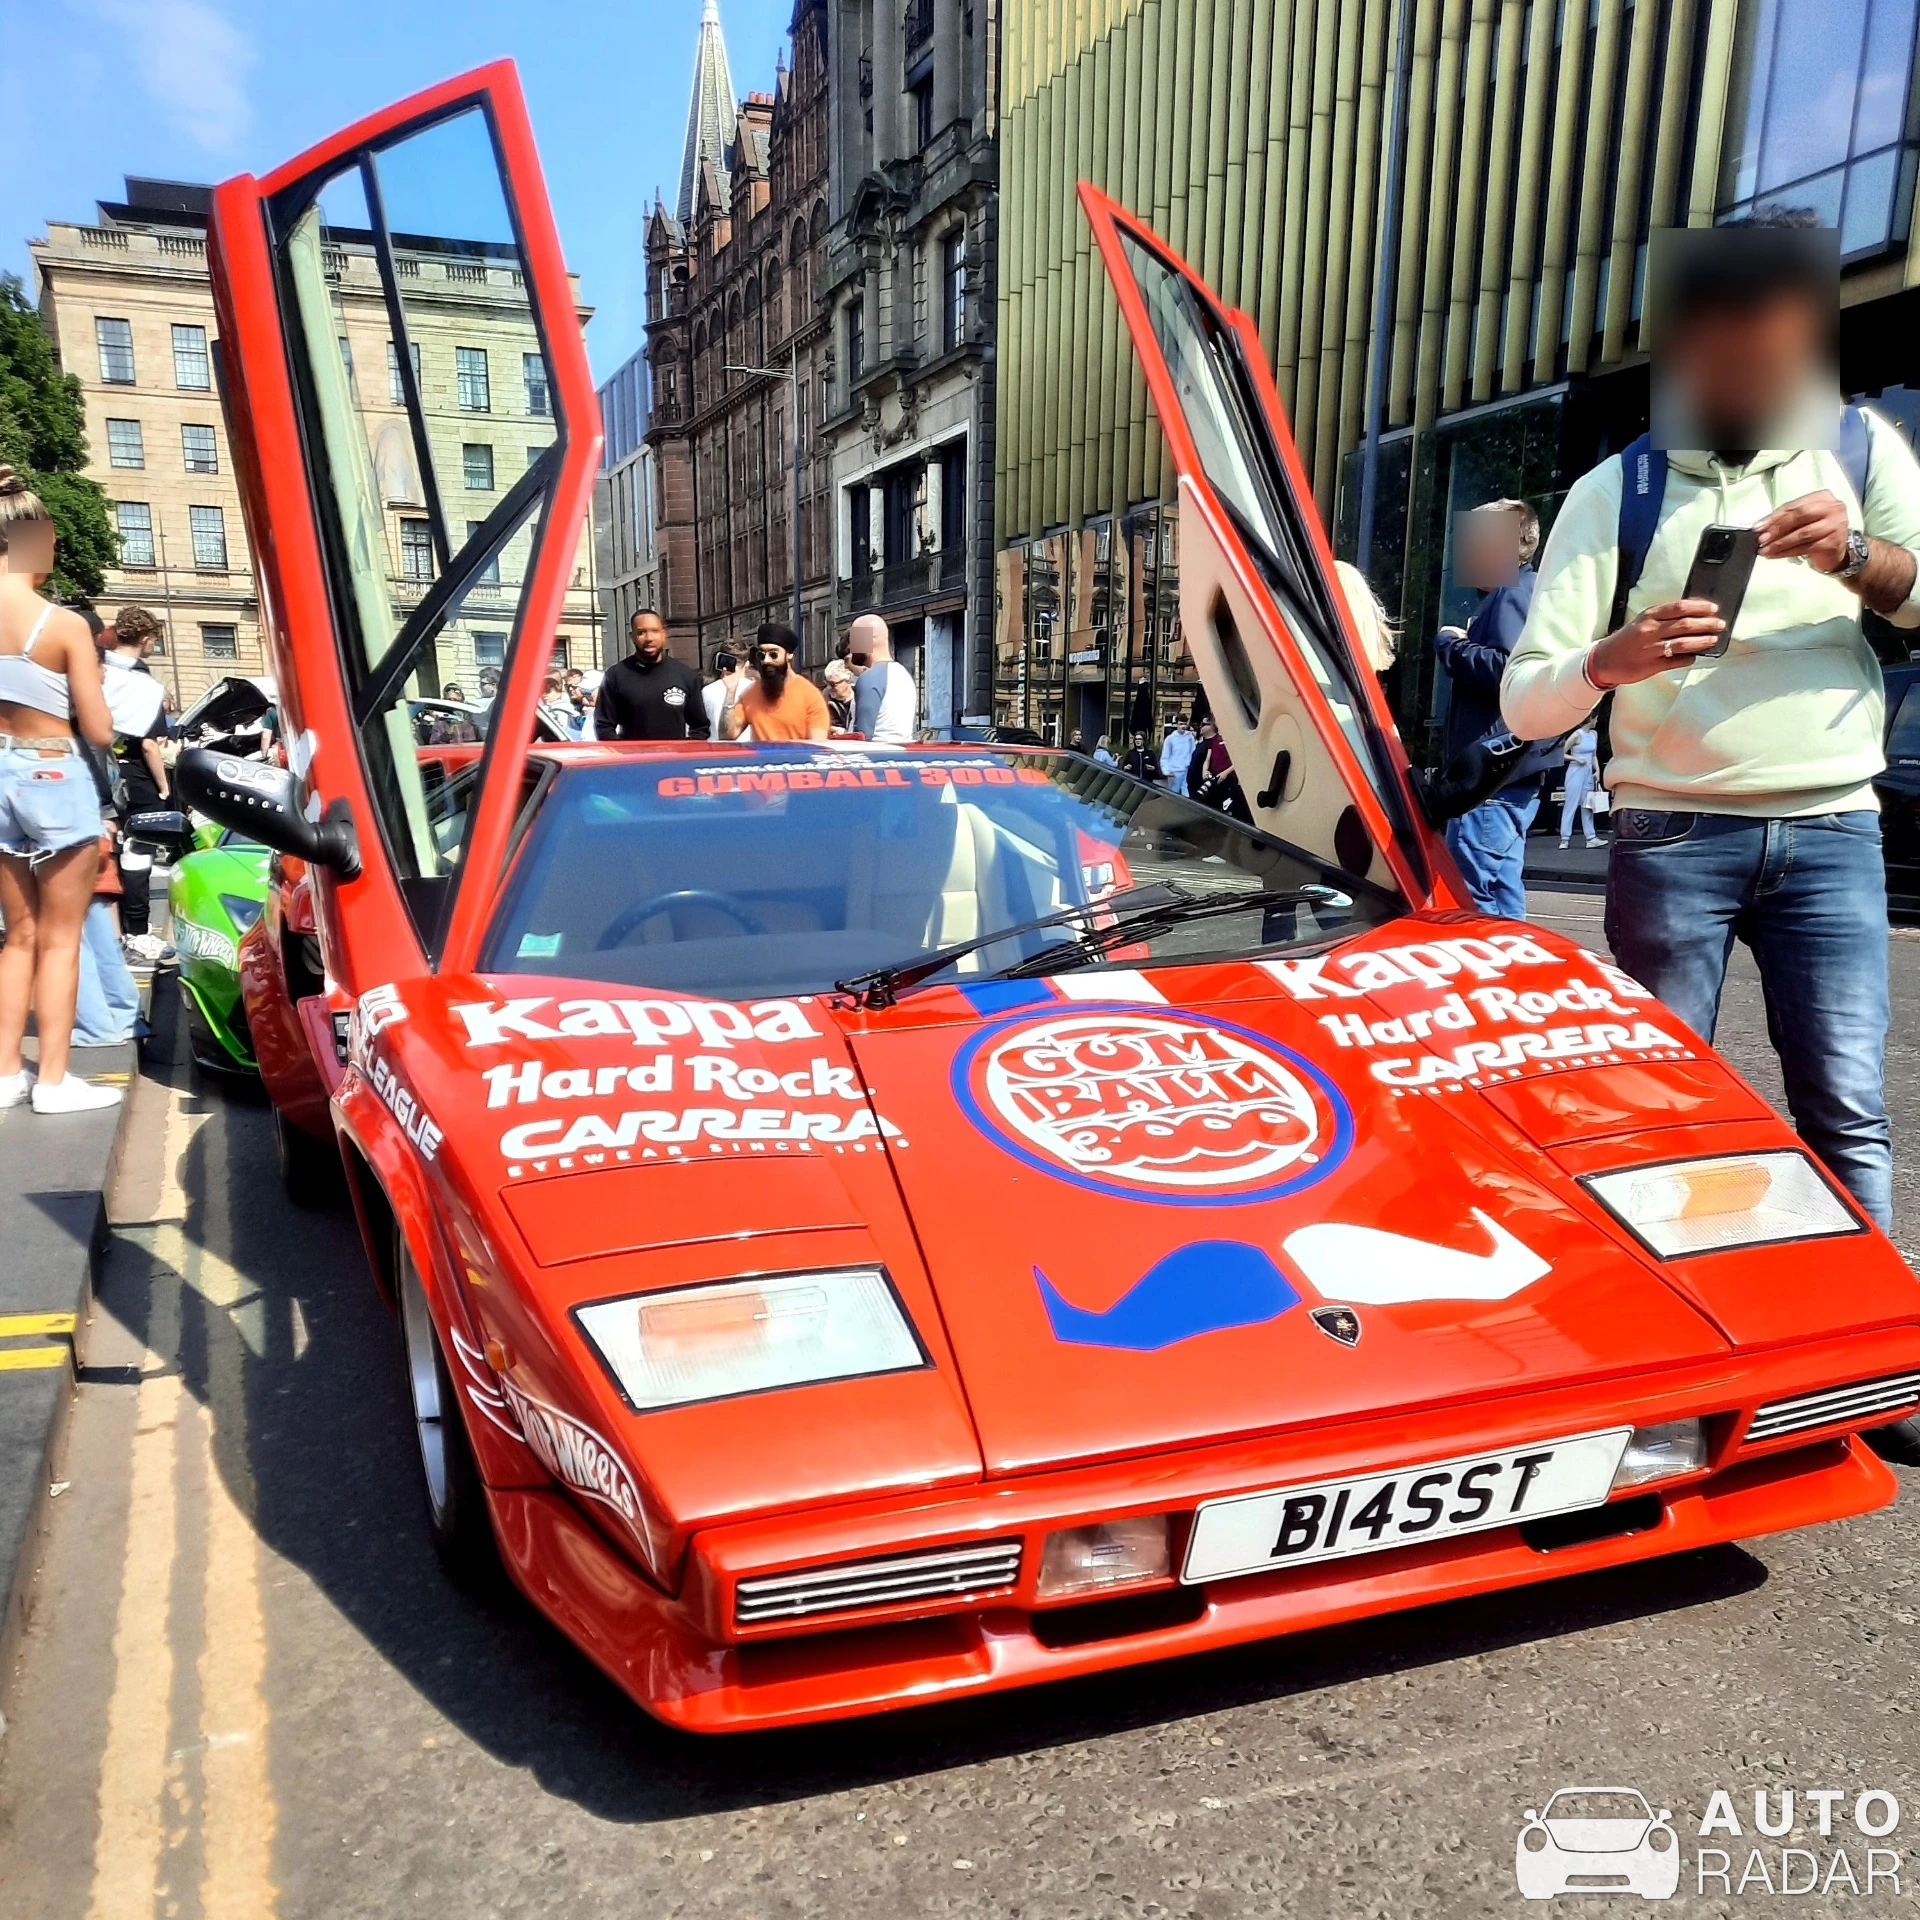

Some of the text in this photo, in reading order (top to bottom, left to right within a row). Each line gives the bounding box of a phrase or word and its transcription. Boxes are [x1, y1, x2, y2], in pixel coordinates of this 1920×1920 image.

[206, 787, 284, 813] LONDON
[657, 767, 1051, 798] GUMBALL 3000
[1257, 934, 1568, 1000] Kappa
[448, 996, 824, 1049] Kappa
[1317, 978, 1634, 1048] Hard Rock
[1369, 1021, 1685, 1087] CARRERA
[1389, 1068, 1525, 1098] EYEWEAR
[1538, 1052, 1623, 1072] SINCE
[364, 1043, 444, 1162] LEAGUE
[481, 1054, 868, 1109] Hard Rock
[500, 1108, 903, 1160] CARRERA
[507, 1145, 684, 1178] EYEWEAR
[708, 1141, 813, 1154] SINCE
